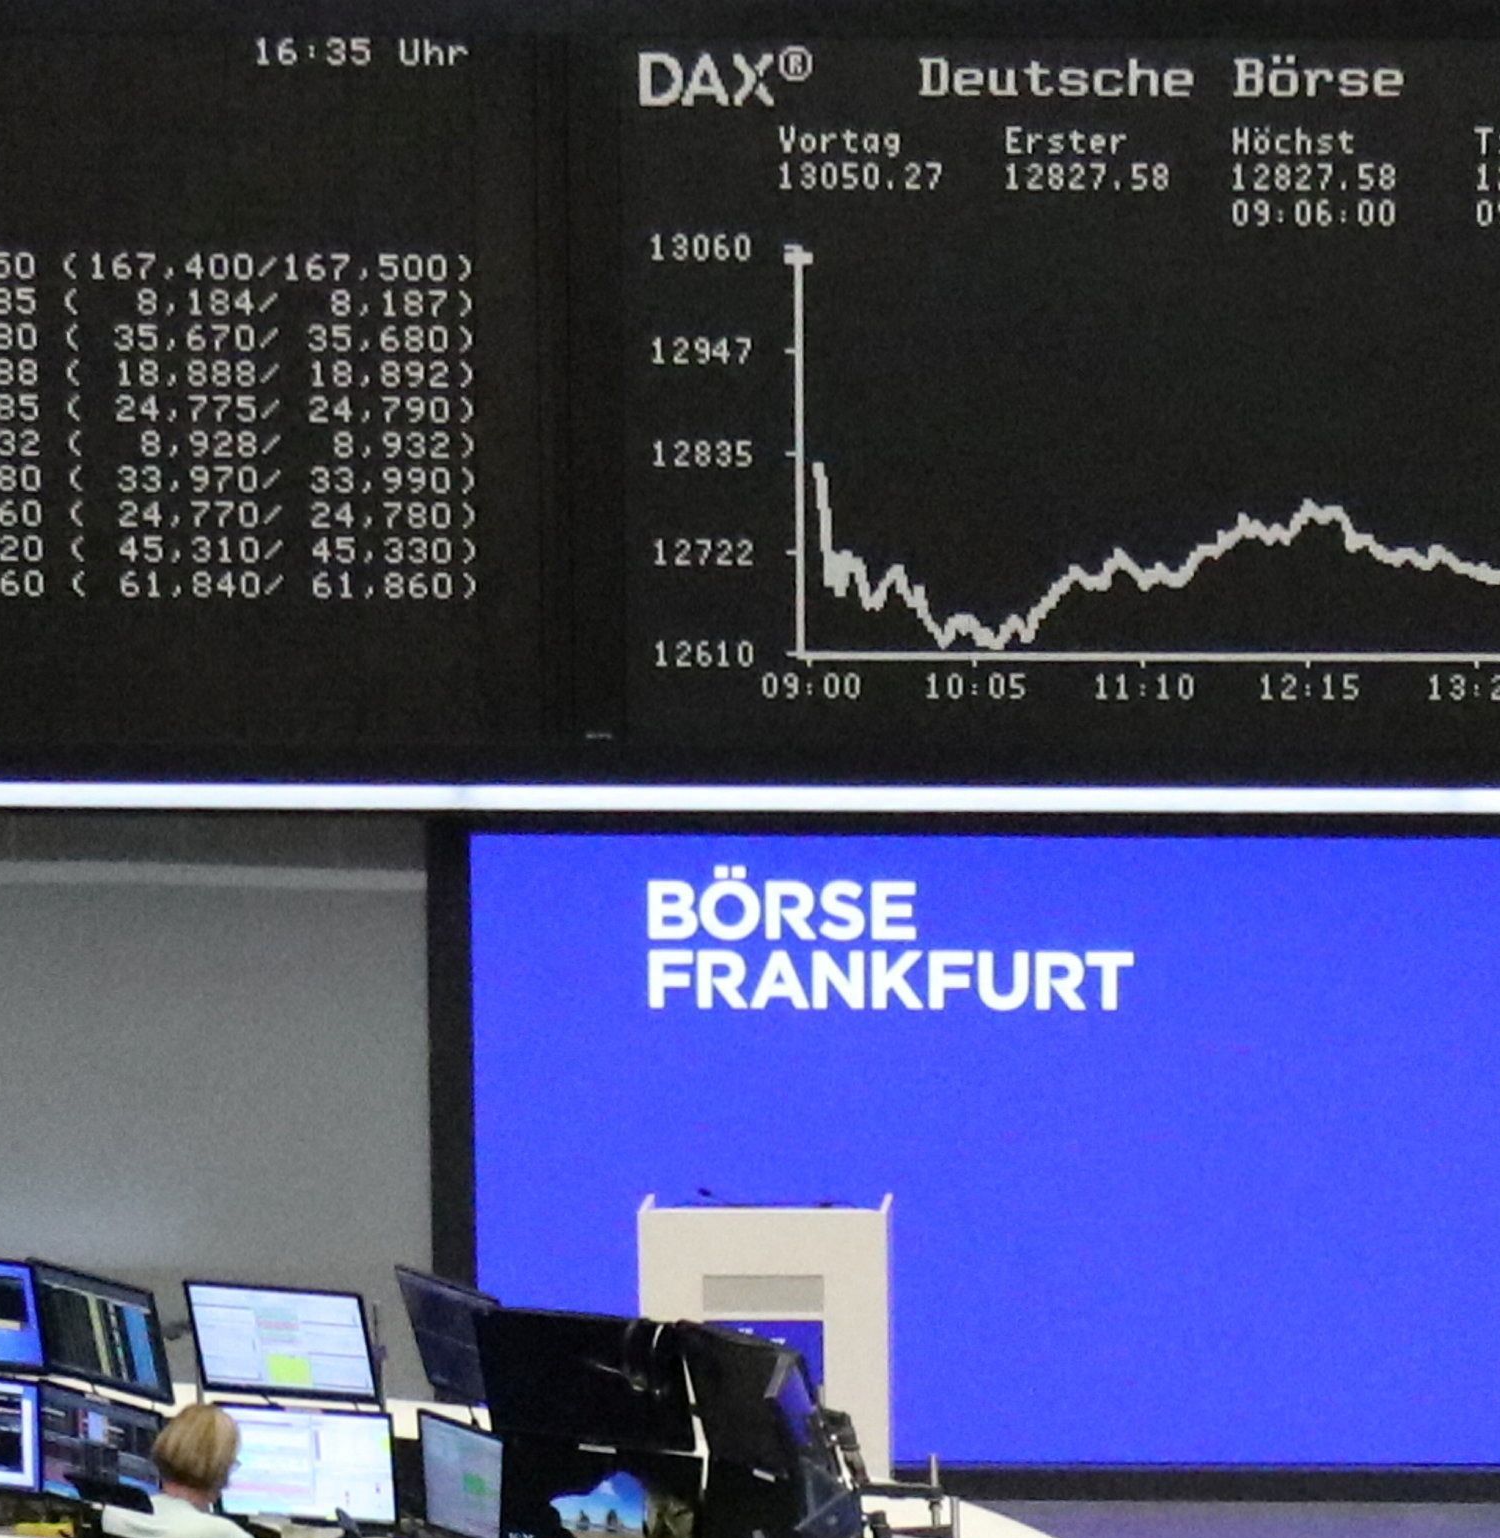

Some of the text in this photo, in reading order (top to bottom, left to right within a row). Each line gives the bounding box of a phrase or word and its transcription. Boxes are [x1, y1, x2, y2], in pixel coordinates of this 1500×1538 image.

[256, 36, 469, 67] 16:35 Uhr
[918, 56, 1194, 97] Deutsche
[1233, 54, 1404, 97] Börse
[778, 125, 901, 158] Vortag
[1005, 125, 1127, 155] Erster
[1232, 126, 1354, 155] Höchst
[779, 161, 943, 191] 13050.27
[1005, 161, 1169, 191] 12827.58
[1232, 162, 1396, 192] 12827.58
[1232, 198, 1396, 227] 09:06:00
[651, 232, 751, 262] 13060
[652, 336, 752, 365] 12947
[653, 439, 753, 468] 12835
[654, 538, 754, 567] 12722
[655, 639, 754, 668] 12610
[761, 671, 861, 700] 09:00
[926, 672, 1026, 700] 10:05
[1095, 673, 1194, 701] 11:10
[1260, 673, 1360, 701] 12:15
[647, 865, 918, 941] BÖRSE
[647, 950, 1135, 1011] FRANKFURT
